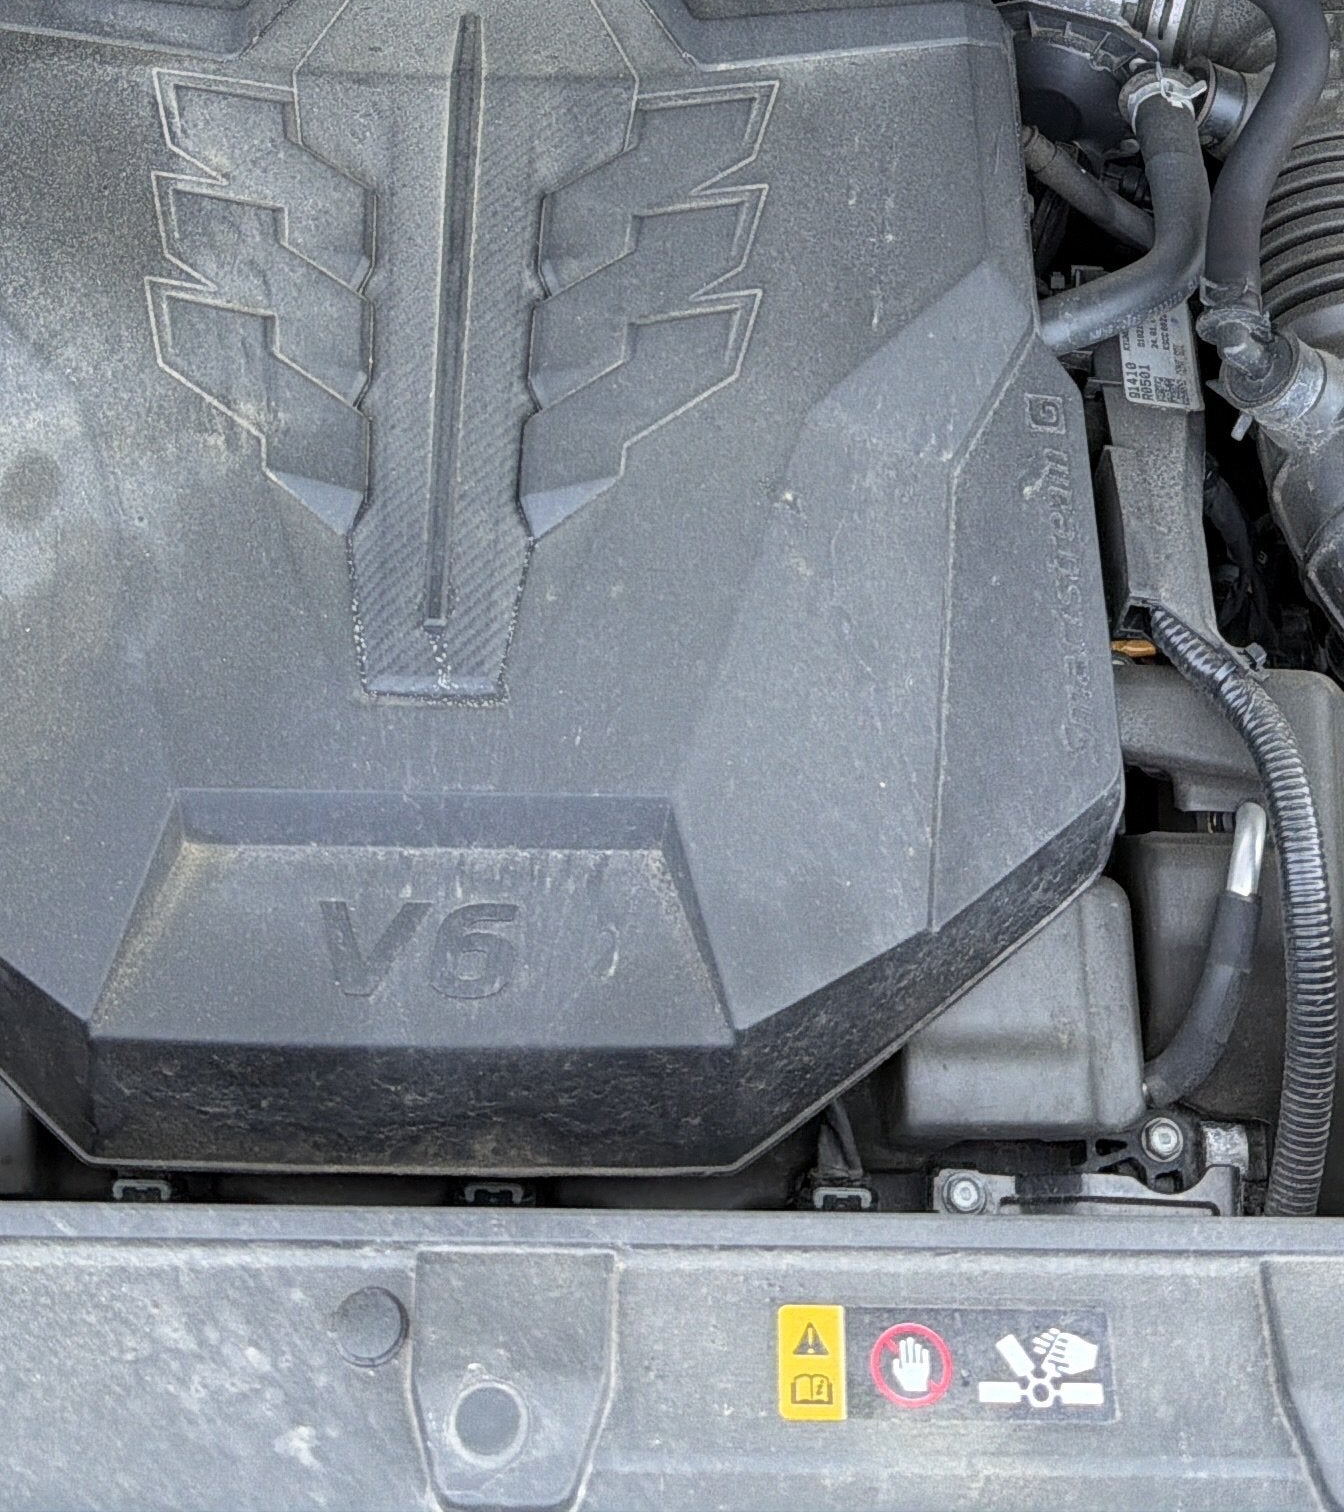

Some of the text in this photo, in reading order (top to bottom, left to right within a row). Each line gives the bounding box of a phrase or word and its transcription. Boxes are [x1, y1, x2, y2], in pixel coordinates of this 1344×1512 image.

[1124, 361, 1141, 399] 91410
[1138, 365, 1154, 401] R0501
[318, 900, 520, 1000] V6
